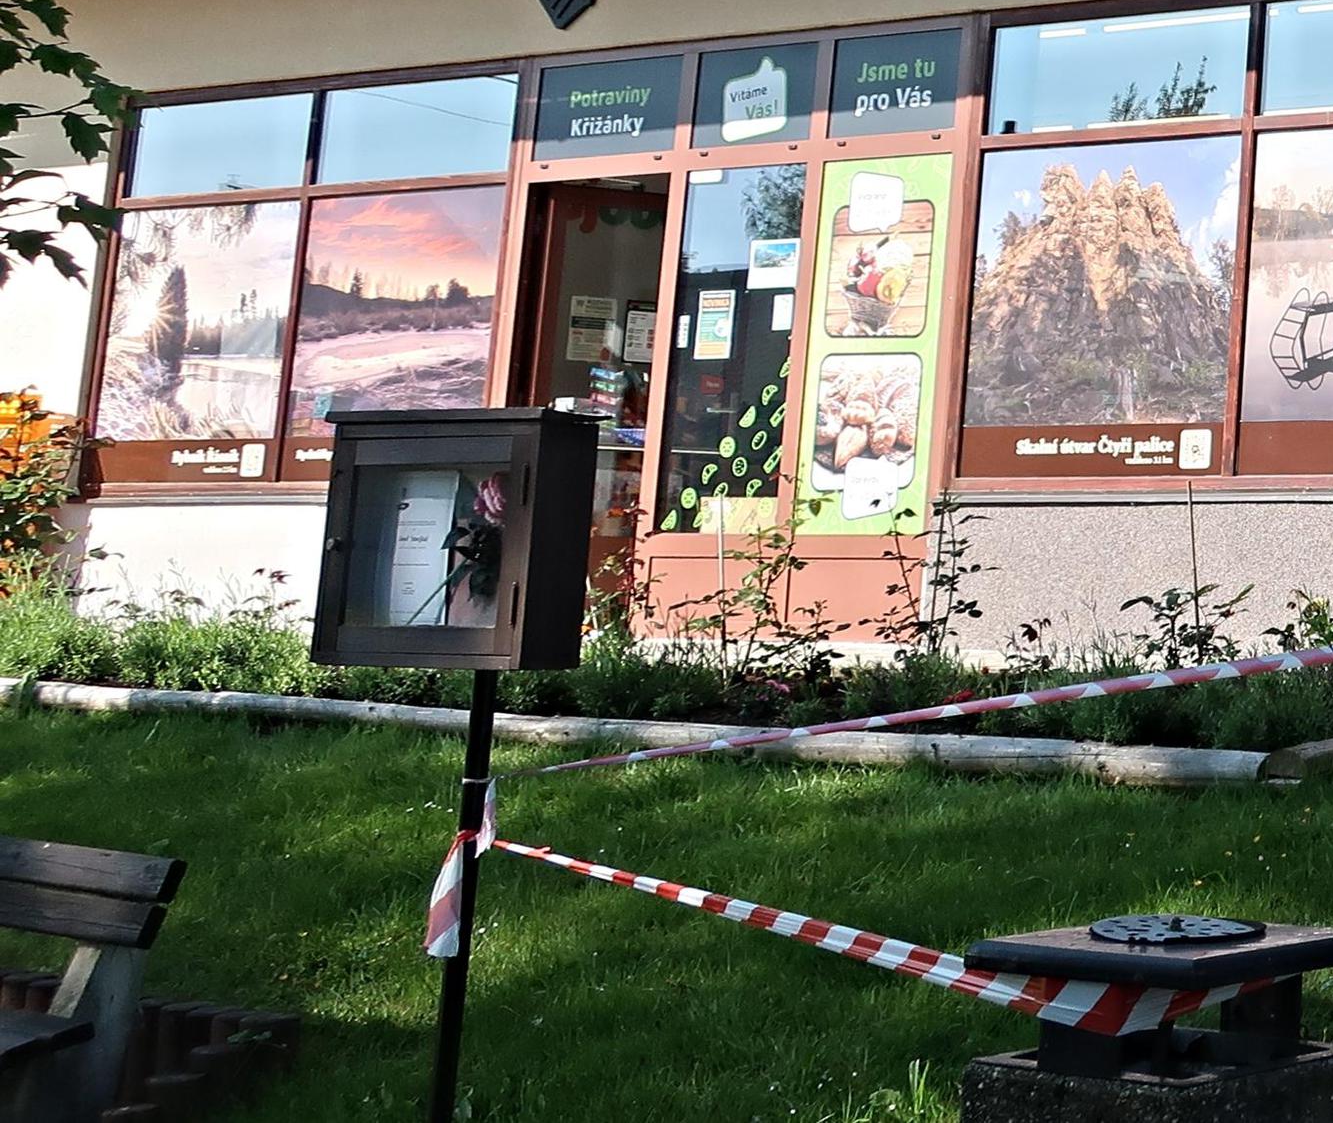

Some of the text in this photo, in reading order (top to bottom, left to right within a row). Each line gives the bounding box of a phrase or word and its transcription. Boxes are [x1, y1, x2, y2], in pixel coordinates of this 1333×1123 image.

[857, 58, 936, 83] Jsme tu
[569, 85, 651, 108] Potraviny
[730, 85, 768, 103] Vítáme
[854, 87, 932, 117] pro Vás
[745, 102, 778, 120] Vás!
[571, 114, 645, 136] Křižánky
[1016, 433, 1175, 457] Skalní útvar Čtyři palice
